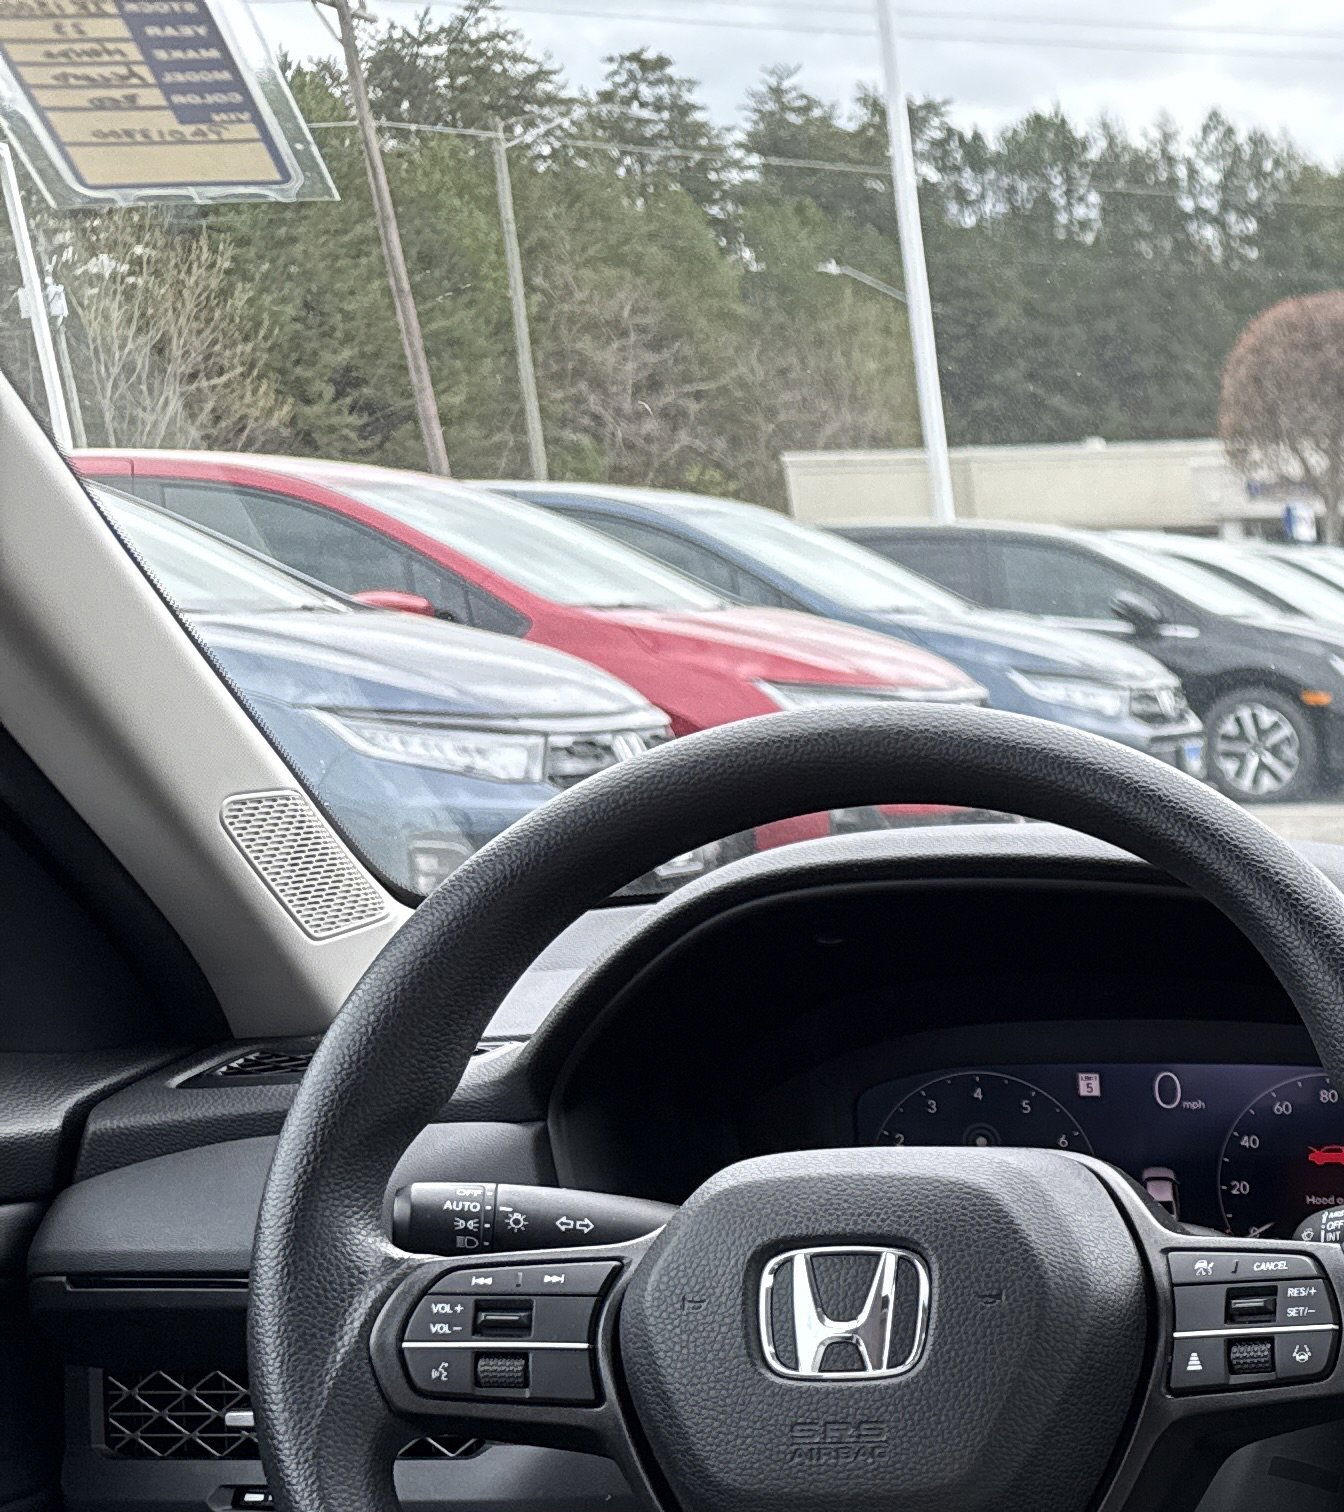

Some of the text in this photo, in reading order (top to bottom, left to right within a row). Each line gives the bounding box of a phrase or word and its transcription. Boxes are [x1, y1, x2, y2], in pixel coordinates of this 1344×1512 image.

[973, 1087, 983, 1101] 4
[1086, 1082, 1094, 1094] 5
[1155, 1071, 1181, 1109] 0
[1319, 1089, 1339, 1103] 80
[927, 1100, 938, 1114] 3
[1021, 1100, 1032, 1114] 5
[1182, 1100, 1206, 1111] mph
[1273, 1101, 1293, 1115] 60
[1057, 1133, 1069, 1148] 6
[1240, 1134, 1260, 1149] 40
[1230, 1181, 1250, 1195] 20
[443, 1200, 481, 1212] AUTO
[1305, 1194, 1335, 1205] Hood
[1326, 1220, 1344, 1231] OFF
[1326, 1231, 1341, 1242] INT
[1253, 1260, 1289, 1272] CANCEL
[788, 1420, 886, 1441] SRS
